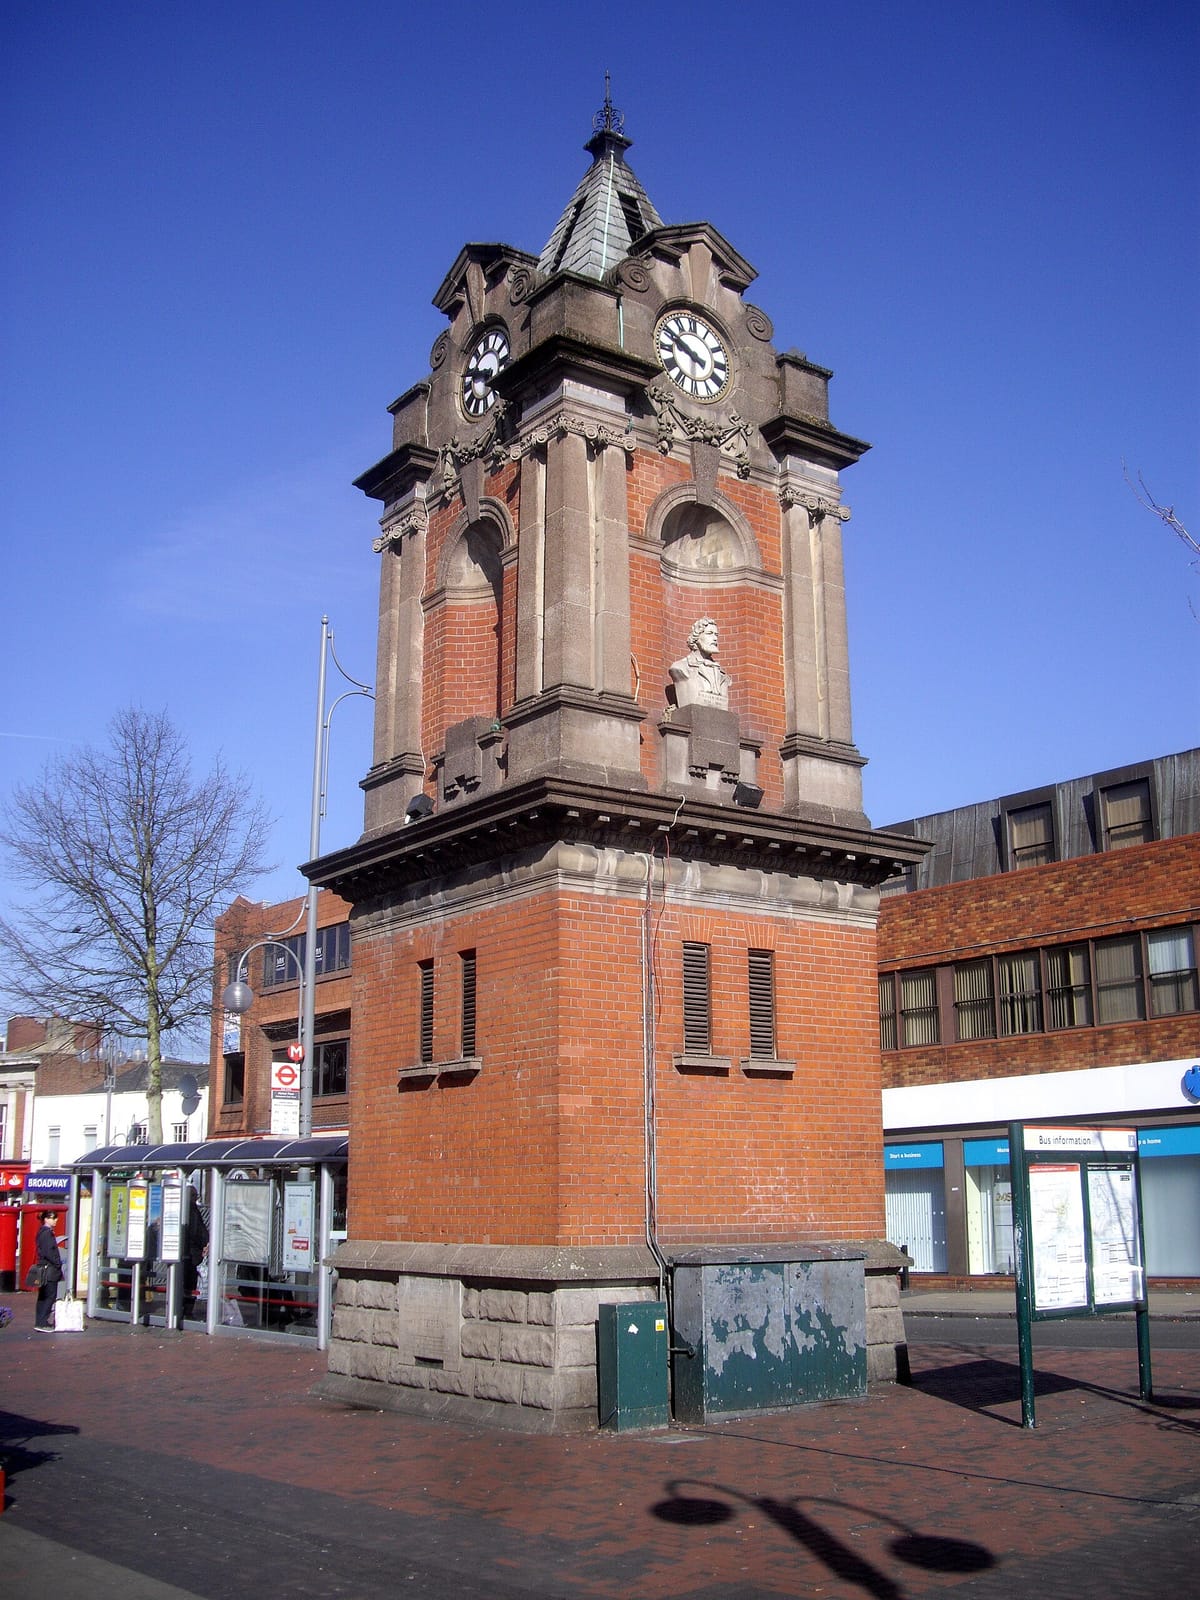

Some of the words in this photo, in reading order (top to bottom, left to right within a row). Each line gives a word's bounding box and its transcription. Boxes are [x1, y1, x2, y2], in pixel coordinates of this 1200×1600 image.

[290, 1045, 302, 1057] M
[1039, 1135, 1051, 1145] Bus
[1052, 1135, 1091, 1145] information
[28, 1178, 69, 1188] BROADWAY
